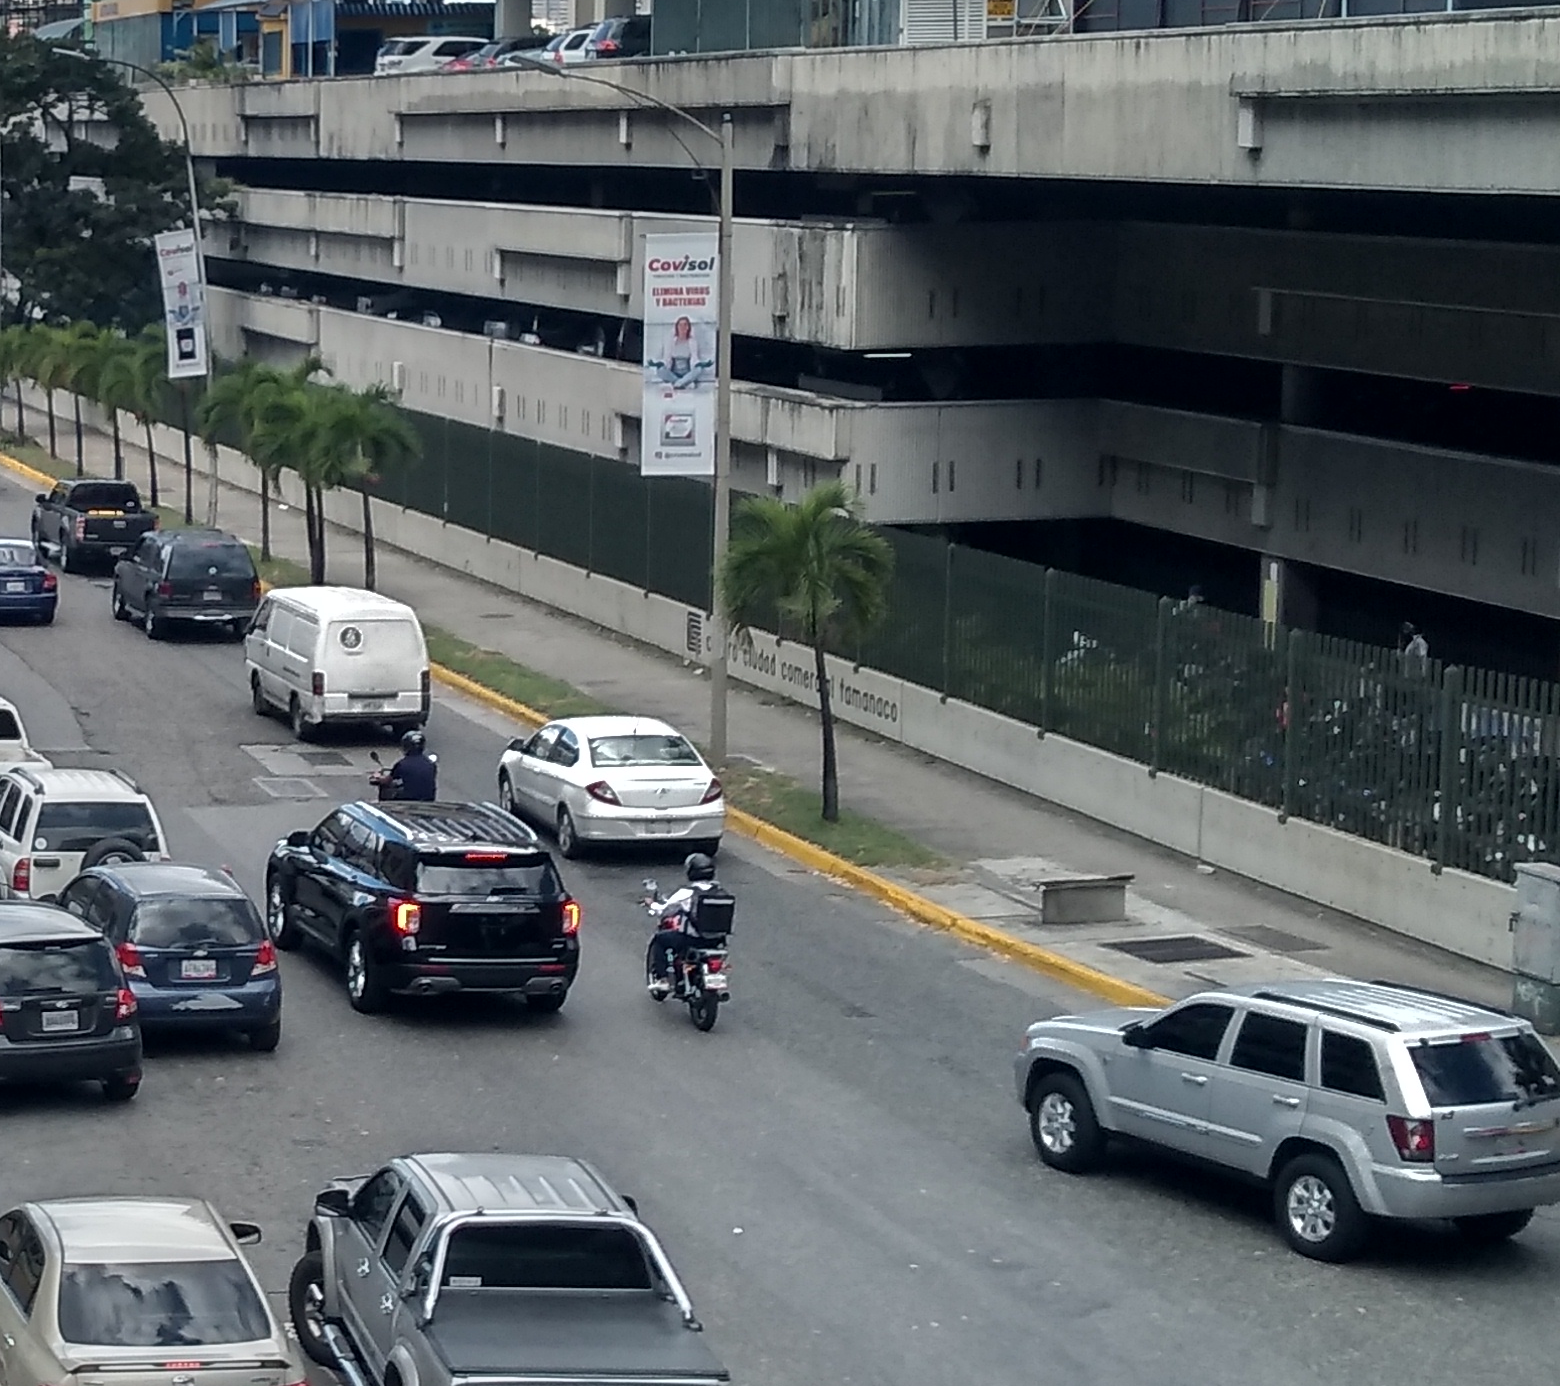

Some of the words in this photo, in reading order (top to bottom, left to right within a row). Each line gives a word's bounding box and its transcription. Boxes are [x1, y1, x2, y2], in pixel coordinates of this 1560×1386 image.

[648, 254, 715, 271] Covisol
[652, 287, 684, 296] ELIMINA
[685, 286, 710, 296] VIRUS
[662, 297, 706, 307] BACTERIAS
[840, 674, 897, 723] tamanaco
